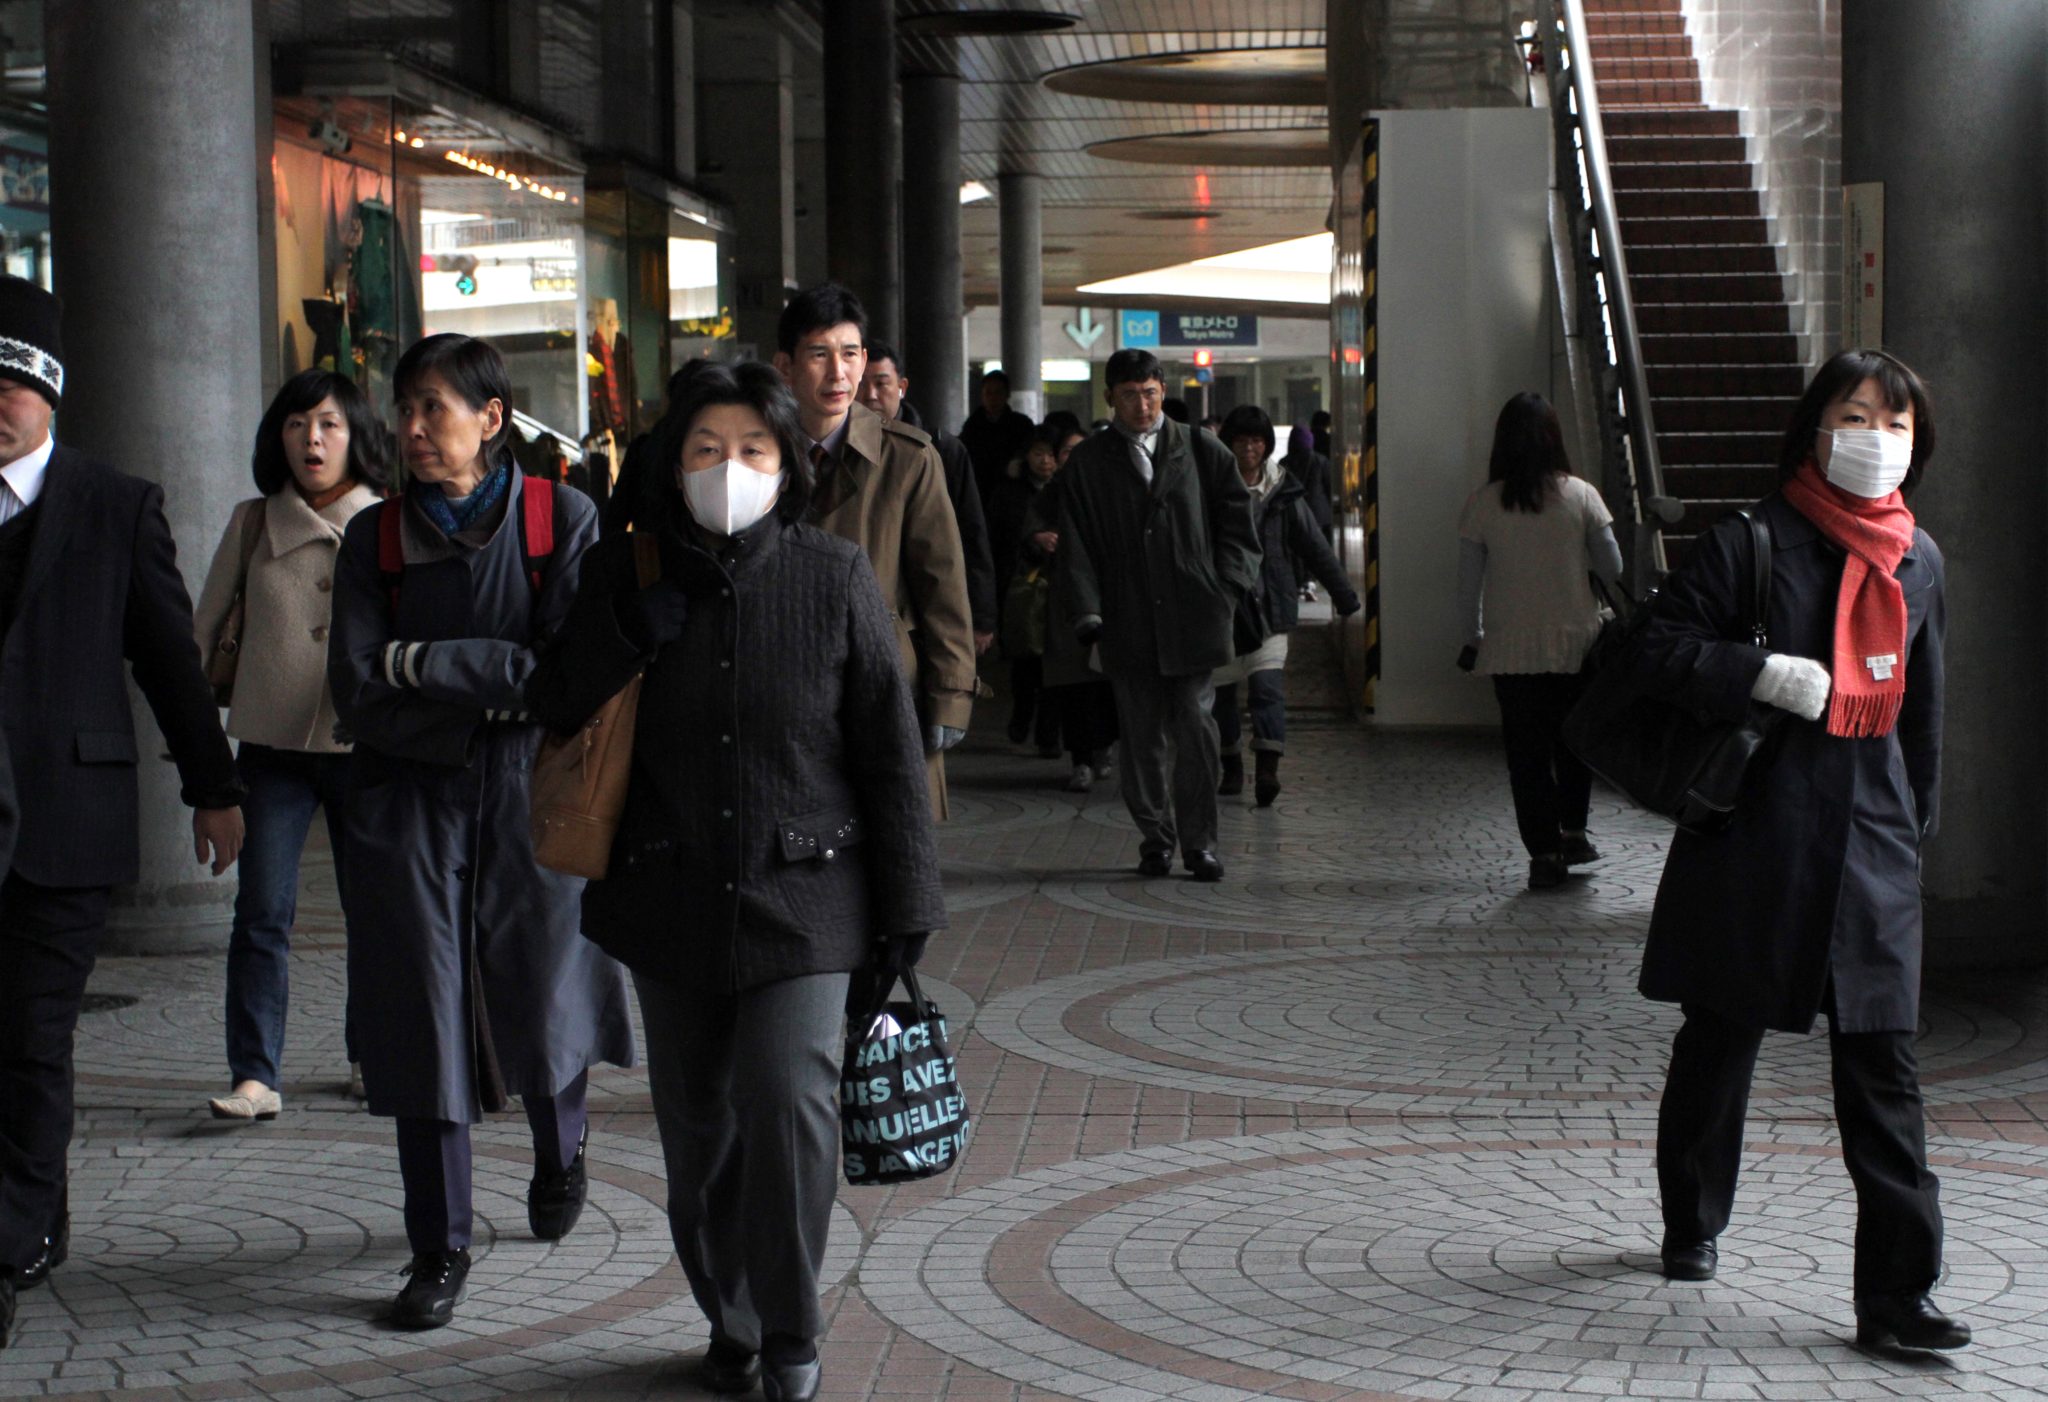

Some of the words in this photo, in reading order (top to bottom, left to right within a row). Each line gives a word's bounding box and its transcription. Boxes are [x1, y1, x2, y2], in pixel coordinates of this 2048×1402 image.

[1179, 316, 1238, 328] 東京メトロ
[1183, 330, 1208, 340] Tokyo
[1209, 330, 1235, 339] Metro
